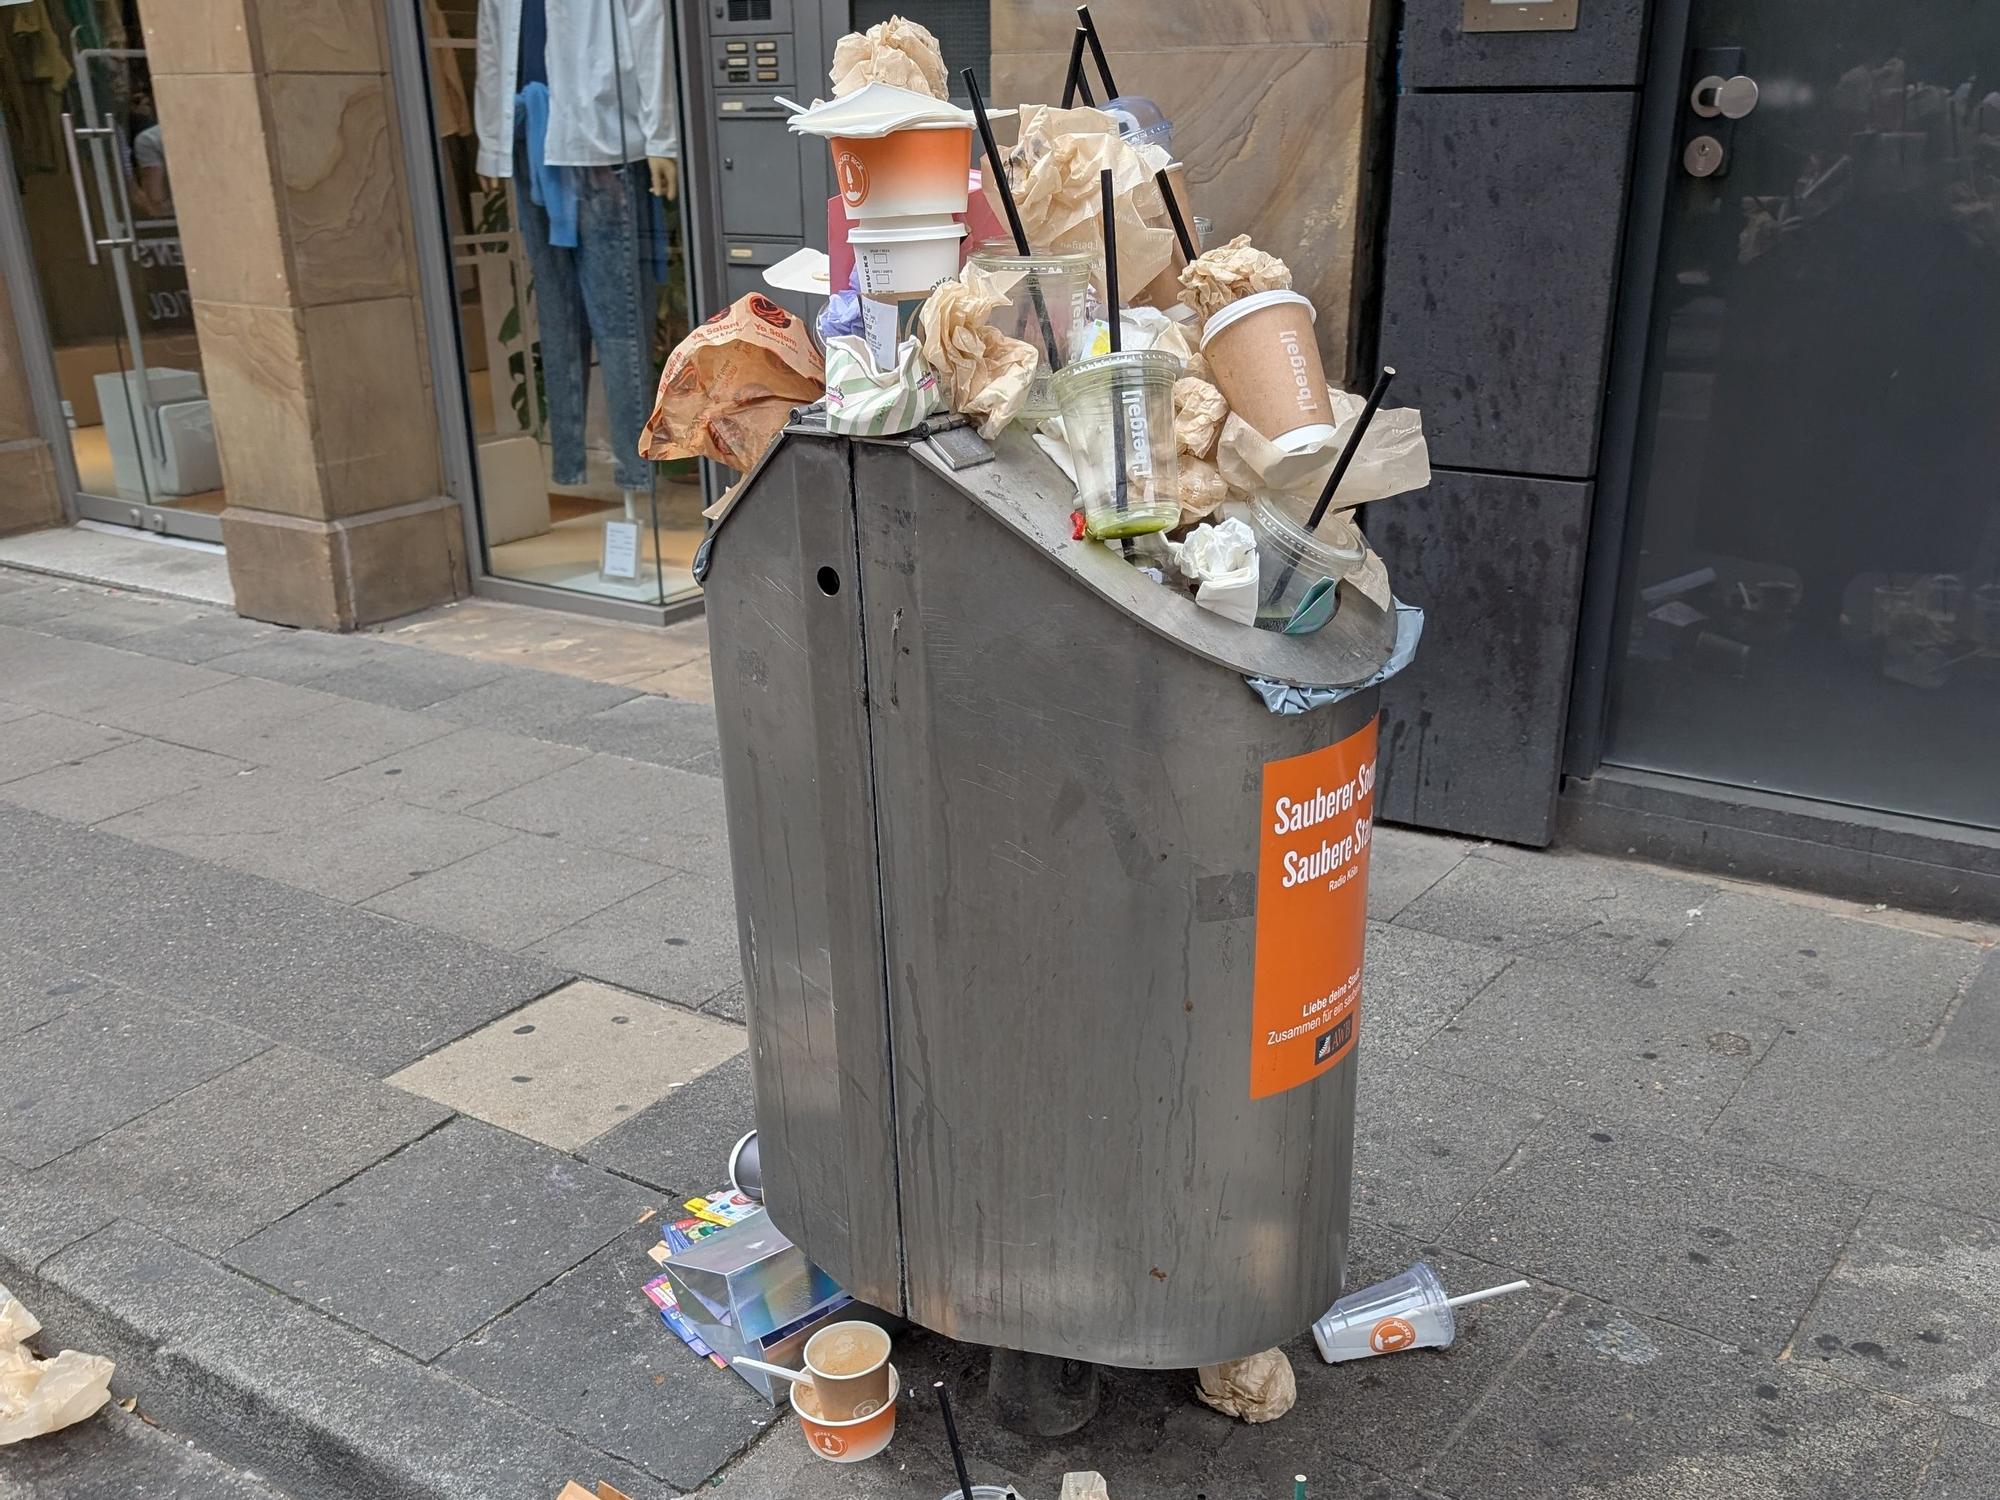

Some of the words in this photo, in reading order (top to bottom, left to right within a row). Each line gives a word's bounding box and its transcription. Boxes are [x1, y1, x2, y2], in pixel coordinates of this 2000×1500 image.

[754, 323, 768, 332] Ya
[769, 328, 798, 347] Salam
[1274, 779, 1356, 835] Sauberer
[1282, 835, 1352, 888] Saubere
[1328, 874, 1346, 892] Radio
[1346, 865, 1358, 881] Köln
[1302, 998, 1327, 1017] Liebe
[1328, 983, 1347, 1004] deine
[1267, 1017, 1320, 1045] Zusammen
[1322, 1009, 1333, 1023] für
[1333, 1001, 1344, 1017] ein
[1331, 1019, 1351, 1051] AWB
